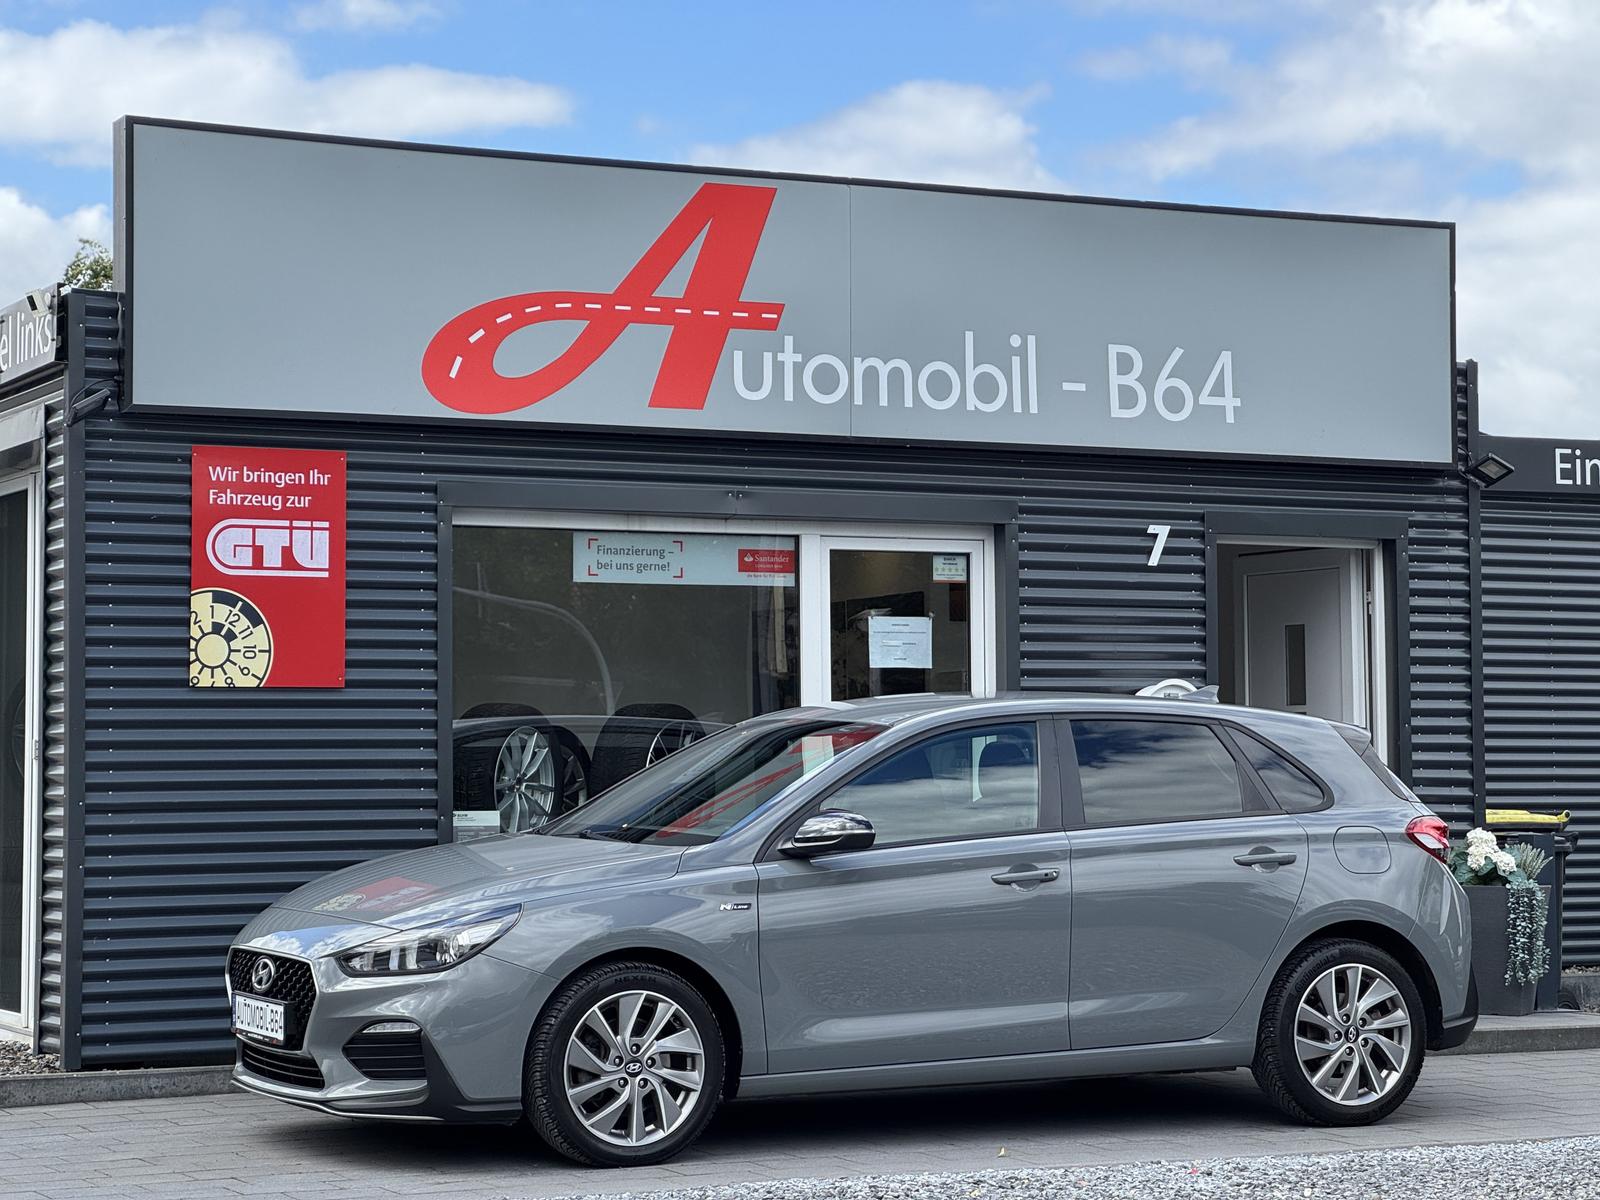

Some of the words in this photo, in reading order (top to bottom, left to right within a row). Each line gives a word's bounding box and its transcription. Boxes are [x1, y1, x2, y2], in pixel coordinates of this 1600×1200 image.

[421, 182, 1039, 415] Automobil
[1061, 381, 1087, 392] -
[1107, 343, 1242, 425] B64
[16, 311, 52, 365] links
[208, 466, 240, 483] Wir
[243, 467, 305, 487] bringen
[309, 469, 332, 486] Ihr
[1554, 448, 1600, 486] Ein
[208, 489, 282, 510] Fahrzeug
[286, 495, 312, 508] zur
[208, 519, 330, 573] GTÜ
[596, 545, 666, 560] Finanzierung
[1146, 524, 1171, 567] 7
[596, 559, 613, 571] bei
[615, 561, 635, 572] uns
[636, 561, 670, 574] gerne!
[754, 553, 791, 563] Santander
[224, 609, 241, 628] 12
[242, 644, 257, 660] 10
[614, 974, 657, 985] NEXEN
